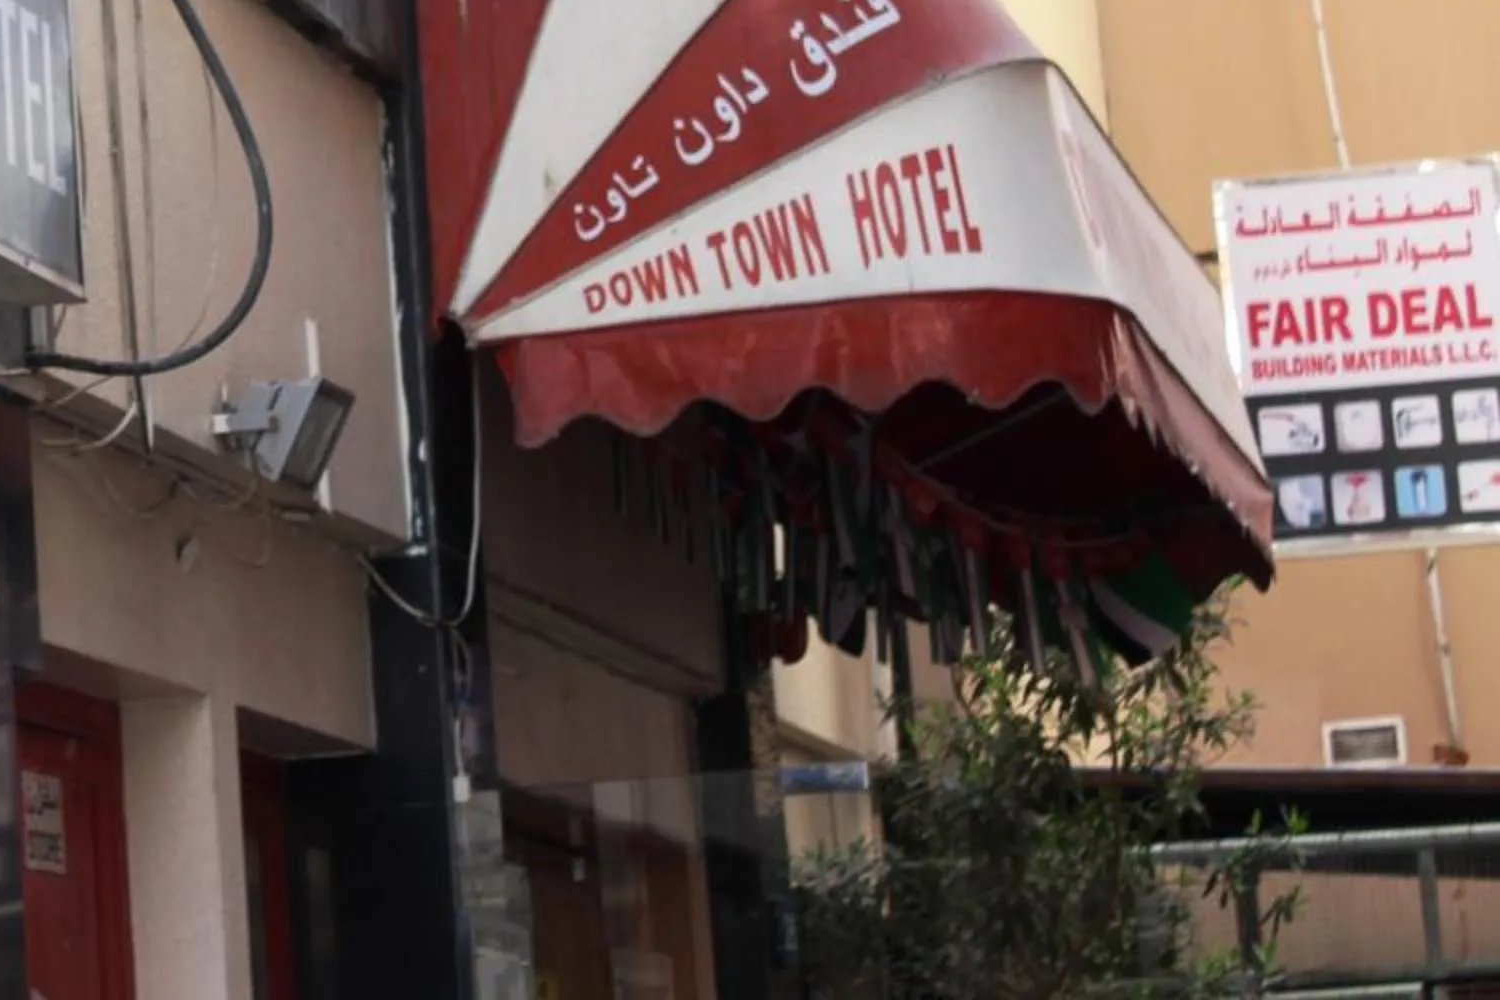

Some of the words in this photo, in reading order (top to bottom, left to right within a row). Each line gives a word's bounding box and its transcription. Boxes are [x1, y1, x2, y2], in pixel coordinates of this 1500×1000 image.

[674, 67, 770, 166] داون
[573, 155, 661, 241] تاون
[583, 244, 700, 314] DOWN
[706, 193, 831, 290] TOWN
[846, 144, 983, 271] HOTEL
[1246, 295, 1353, 349] FAIR
[1367, 283, 1494, 339] DEAL
[1251, 355, 1337, 381] BUILDING
[1342, 343, 1443, 373] MATERIALS
